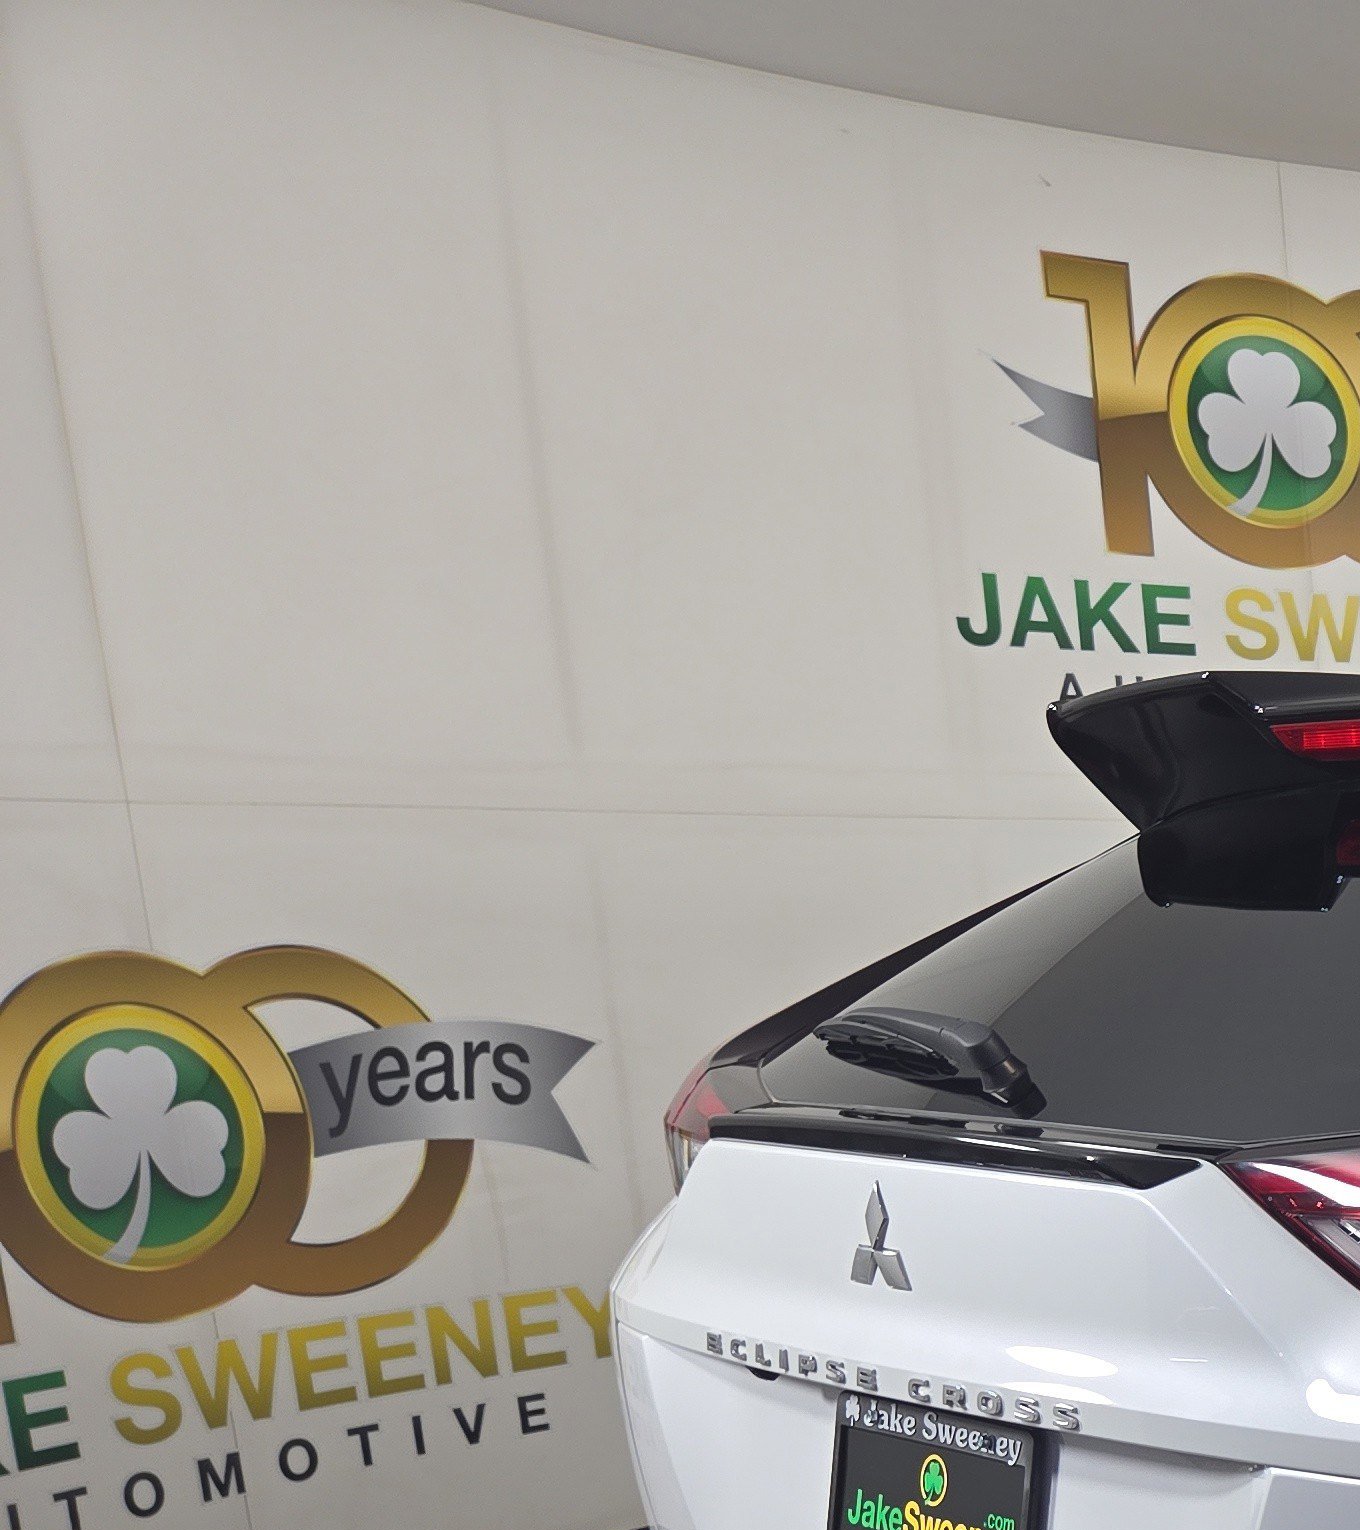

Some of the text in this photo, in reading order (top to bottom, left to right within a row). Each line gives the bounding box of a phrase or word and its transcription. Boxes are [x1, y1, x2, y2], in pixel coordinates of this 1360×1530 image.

[956, 572, 1197, 656] JAKE
[319, 1039, 532, 1137] years
[707, 1332, 1082, 1431] ECLIPSE CROSS
[863, 1399, 916, 1436] Jake
